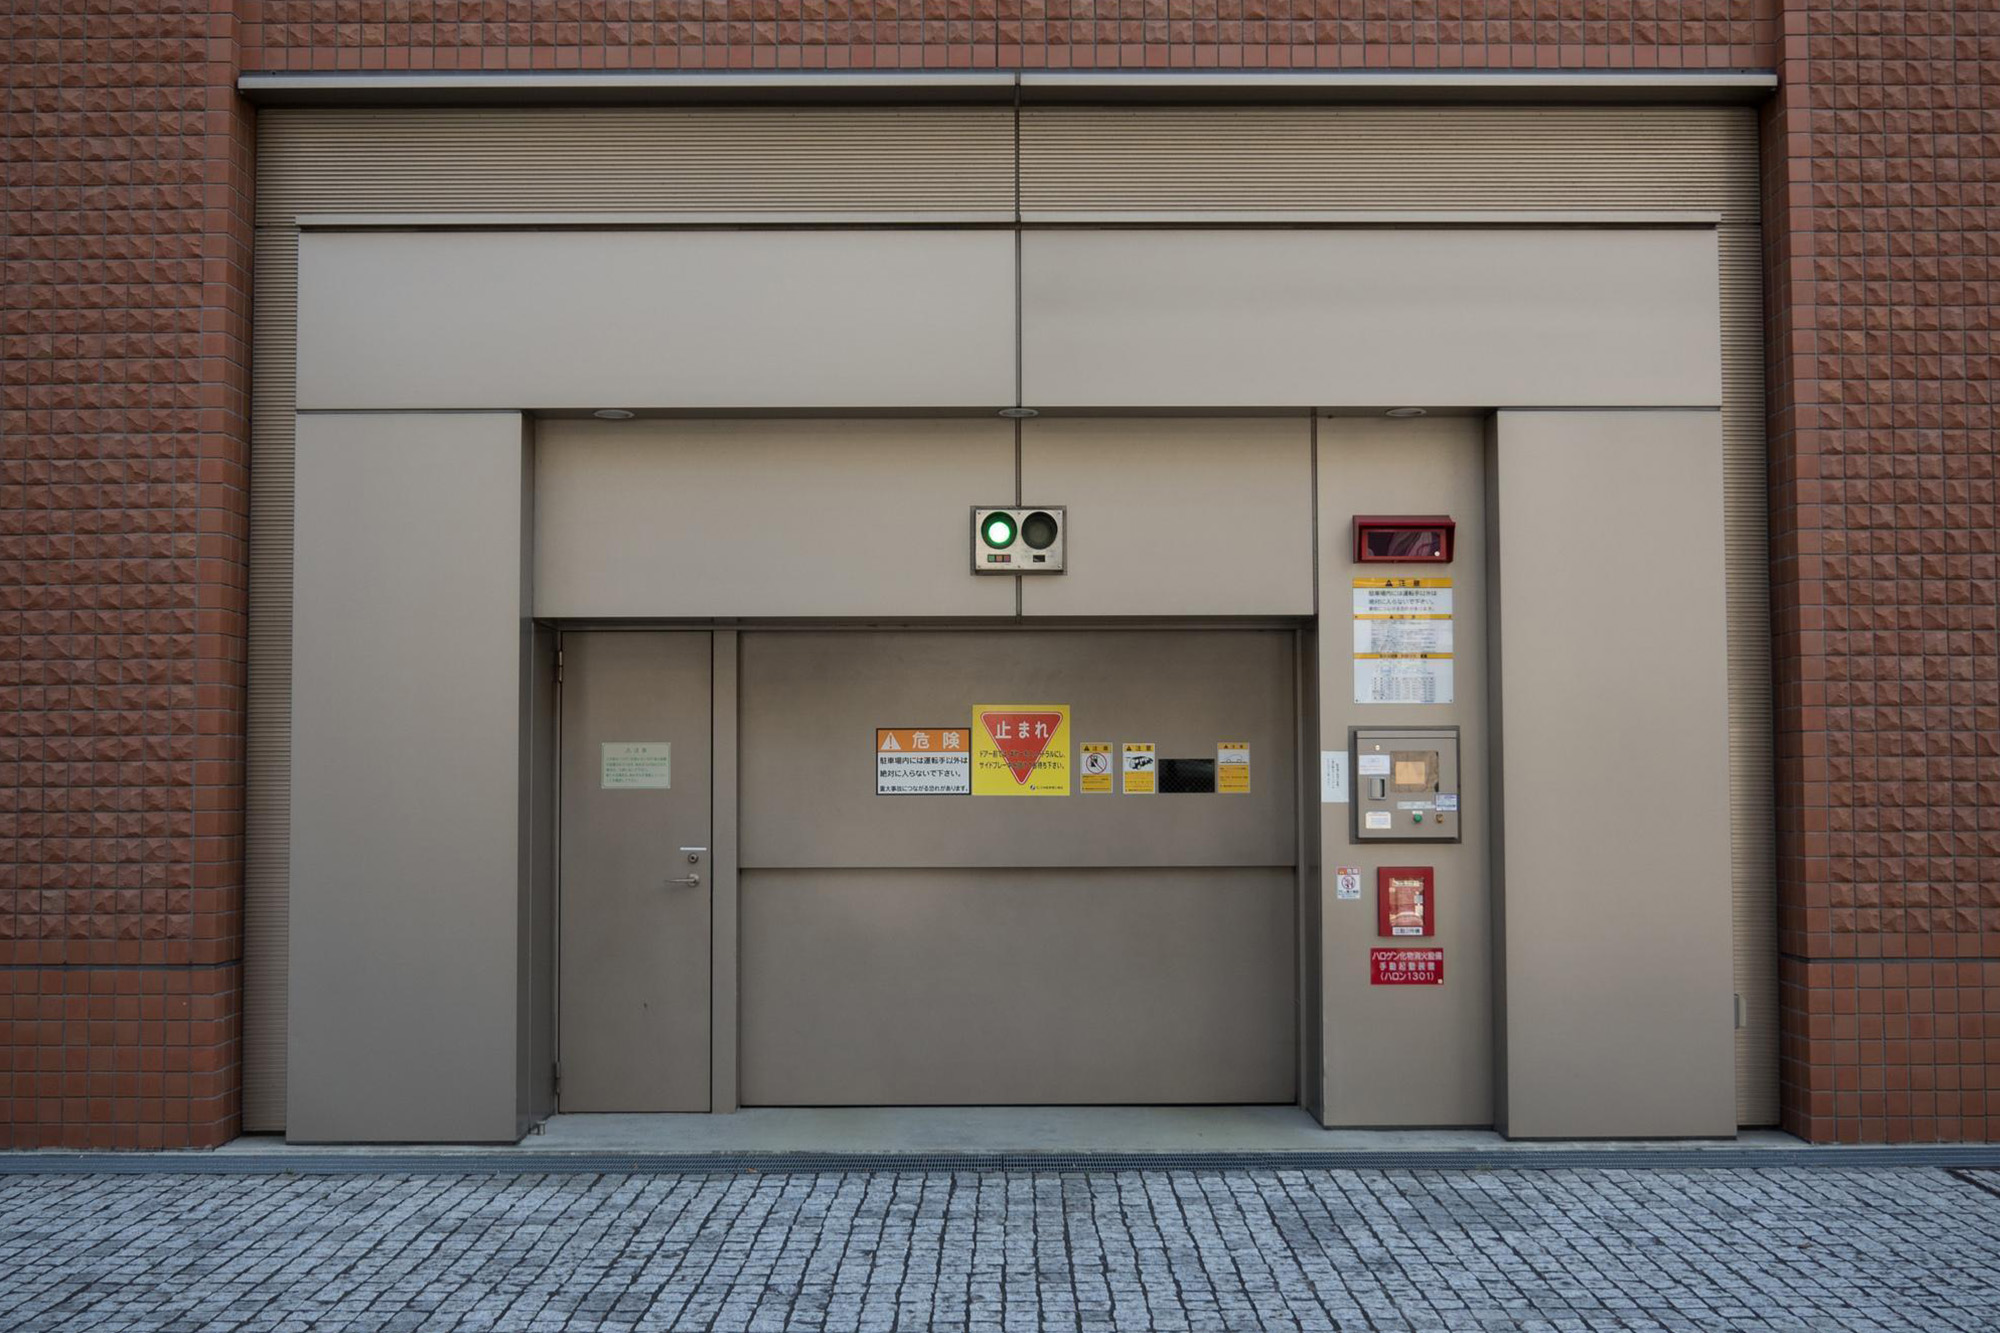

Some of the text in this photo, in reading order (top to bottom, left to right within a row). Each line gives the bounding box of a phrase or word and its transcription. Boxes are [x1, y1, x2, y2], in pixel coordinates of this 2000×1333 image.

[995, 720, 1049, 740] 止まれ
[912, 732, 960, 749] 危険
[880, 756, 968, 764] 駐車場内には運転手以外は
[1372, 951, 1442, 960] ハロゲン化物消火設備
